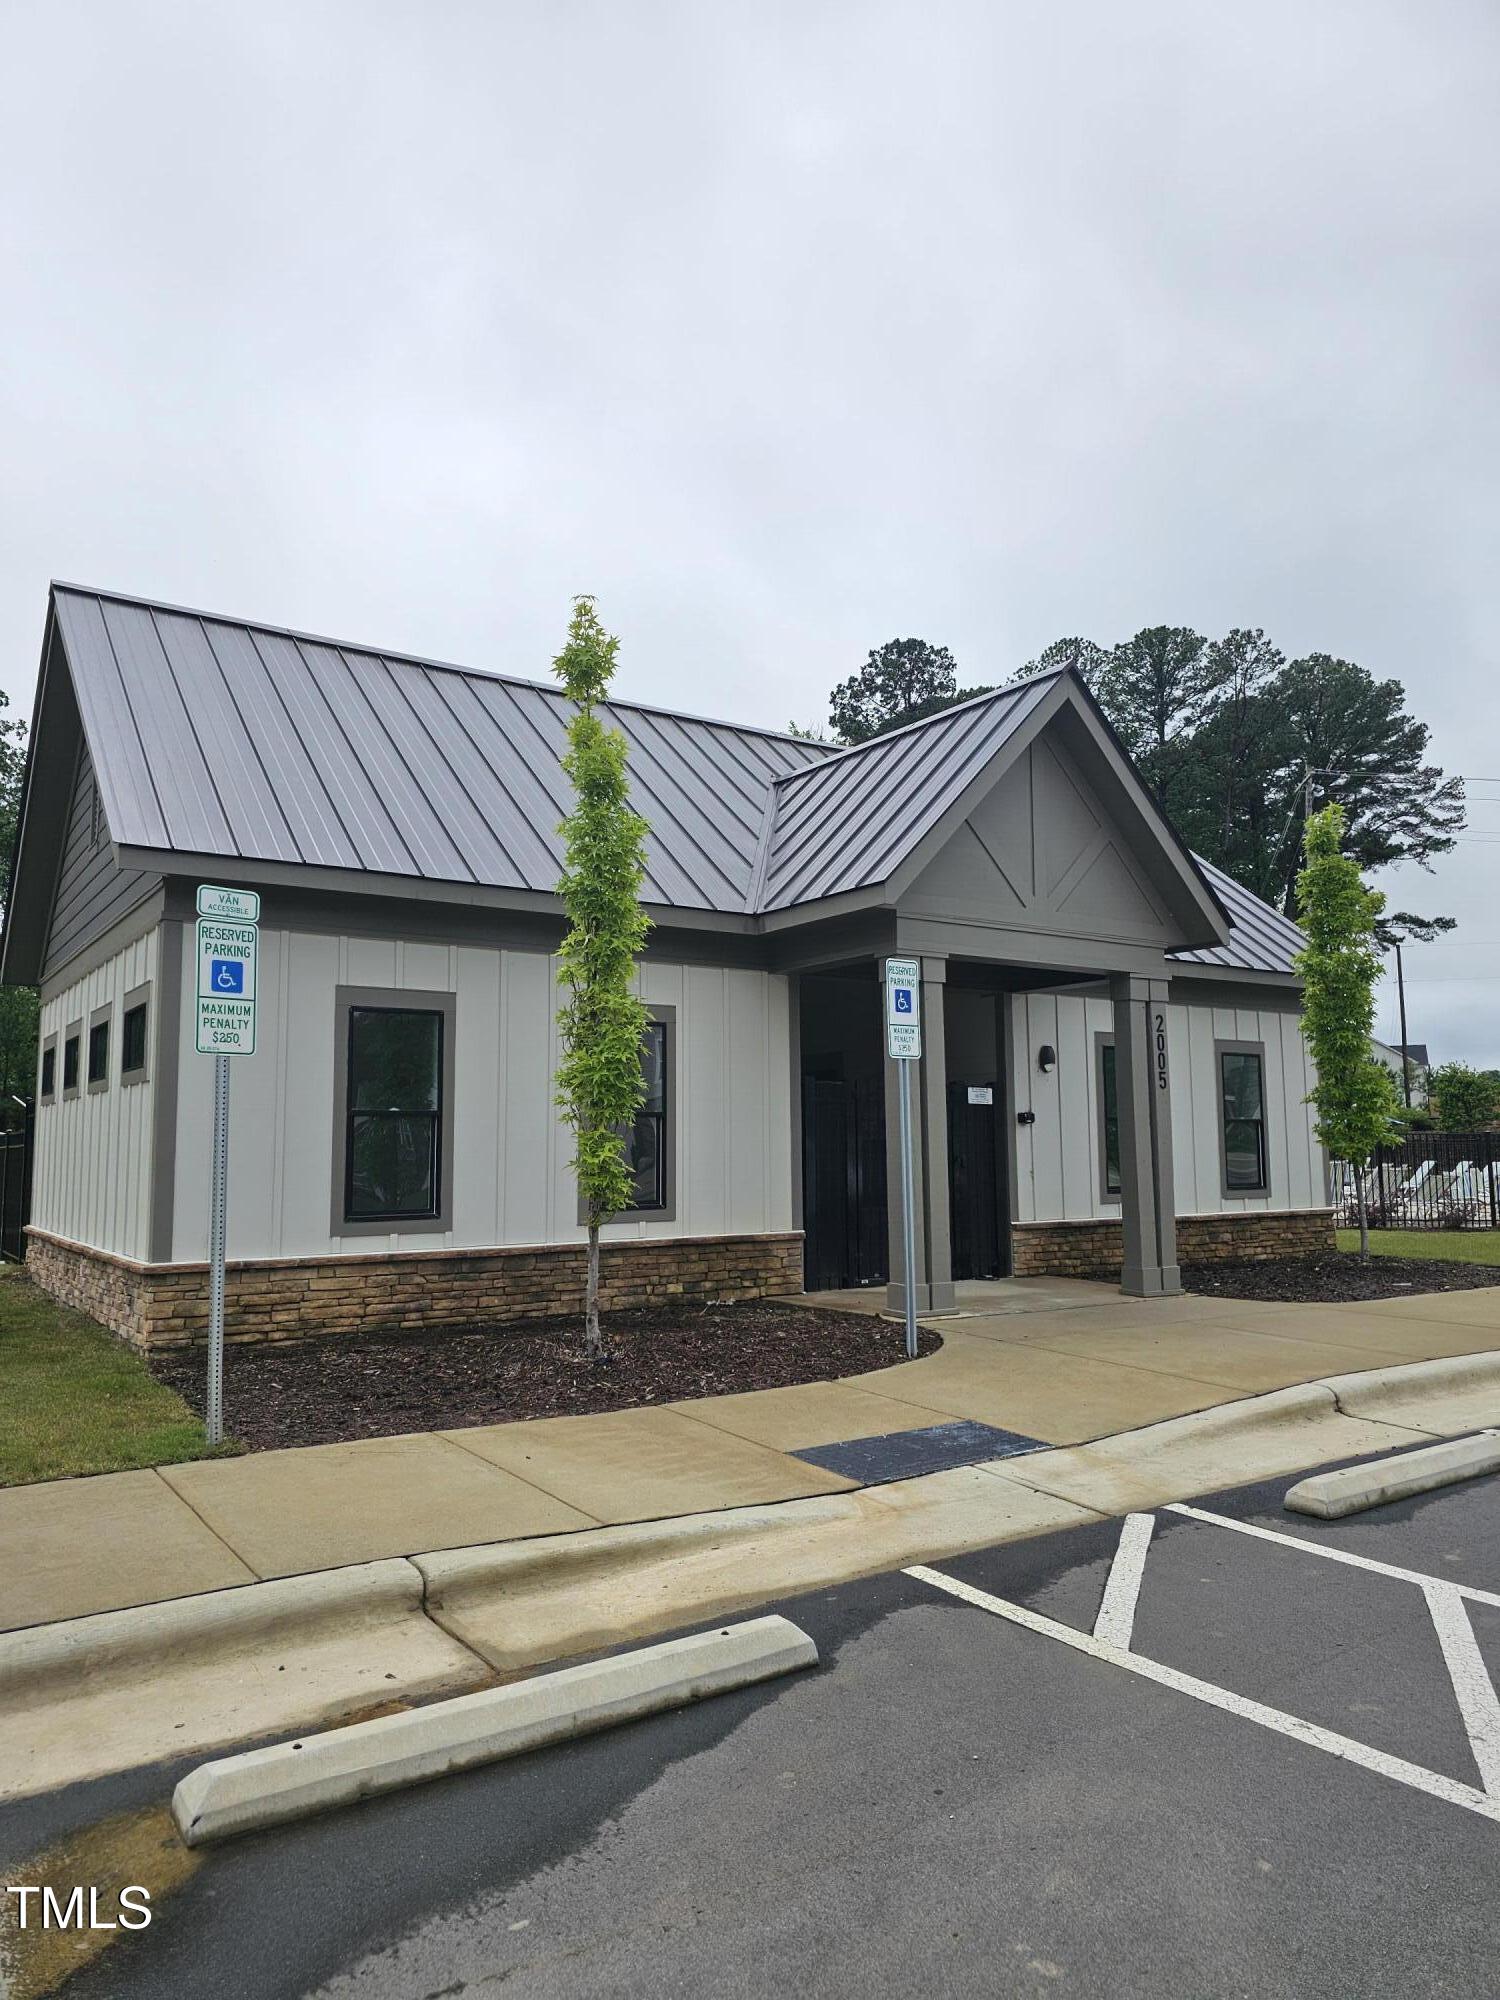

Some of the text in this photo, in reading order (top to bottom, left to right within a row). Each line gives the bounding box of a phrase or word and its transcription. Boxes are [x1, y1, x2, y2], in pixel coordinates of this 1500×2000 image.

[218, 893, 239, 905] VAN
[207, 903, 249, 915] ACCESSIBLE
[201, 926, 254, 943] RESERVED
[205, 943, 250, 958] PARKING
[888, 965, 916, 976] RESERVED
[890, 977, 915, 988] PARKING
[201, 1003, 251, 1017] MAXIMUM
[203, 1017, 249, 1030] PENALTY
[212, 1031, 239, 1044] $250
[1155, 1014, 1167, 1090] 2005
